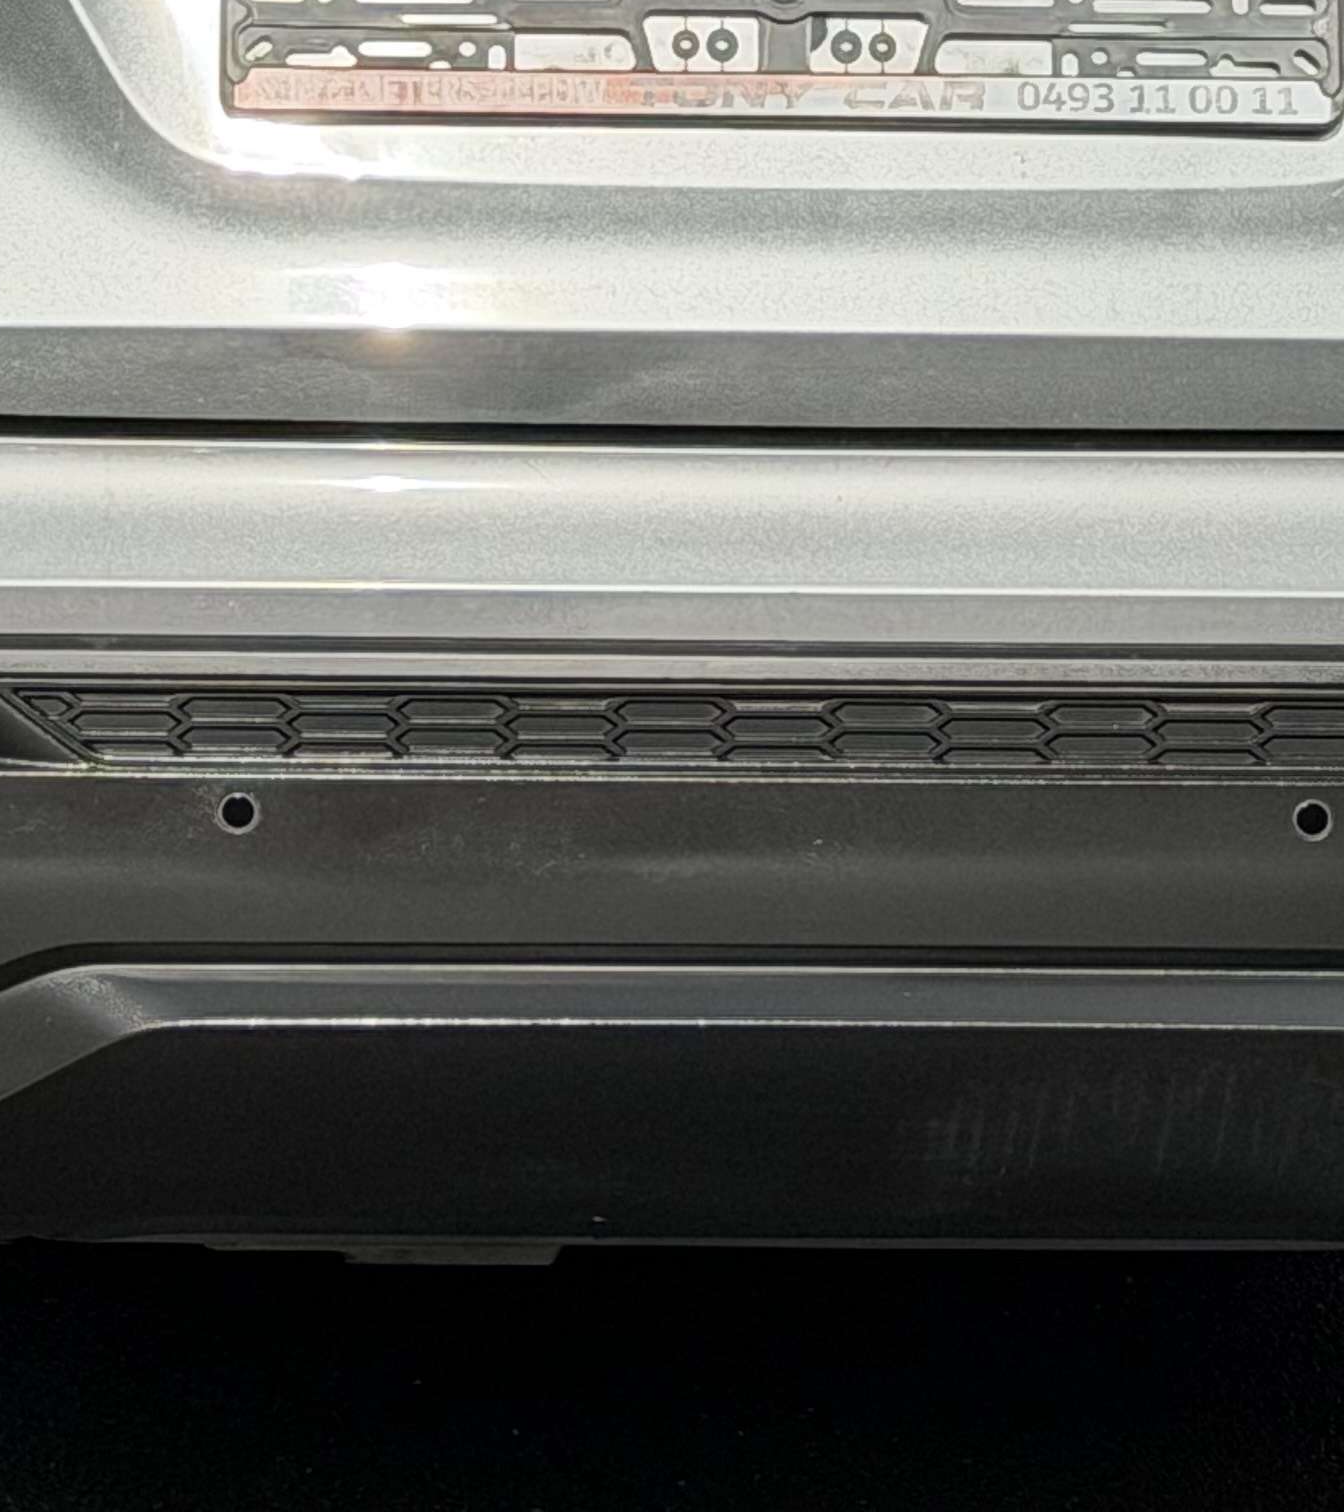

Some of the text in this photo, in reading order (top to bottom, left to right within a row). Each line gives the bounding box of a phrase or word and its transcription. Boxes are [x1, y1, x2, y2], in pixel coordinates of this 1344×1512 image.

[843, 79, 986, 111] CAR
[1017, 81, 1115, 114] 0493
[1129, 85, 1176, 114] 11
[1188, 85, 1239, 115] 00
[1252, 87, 1299, 116] 11
